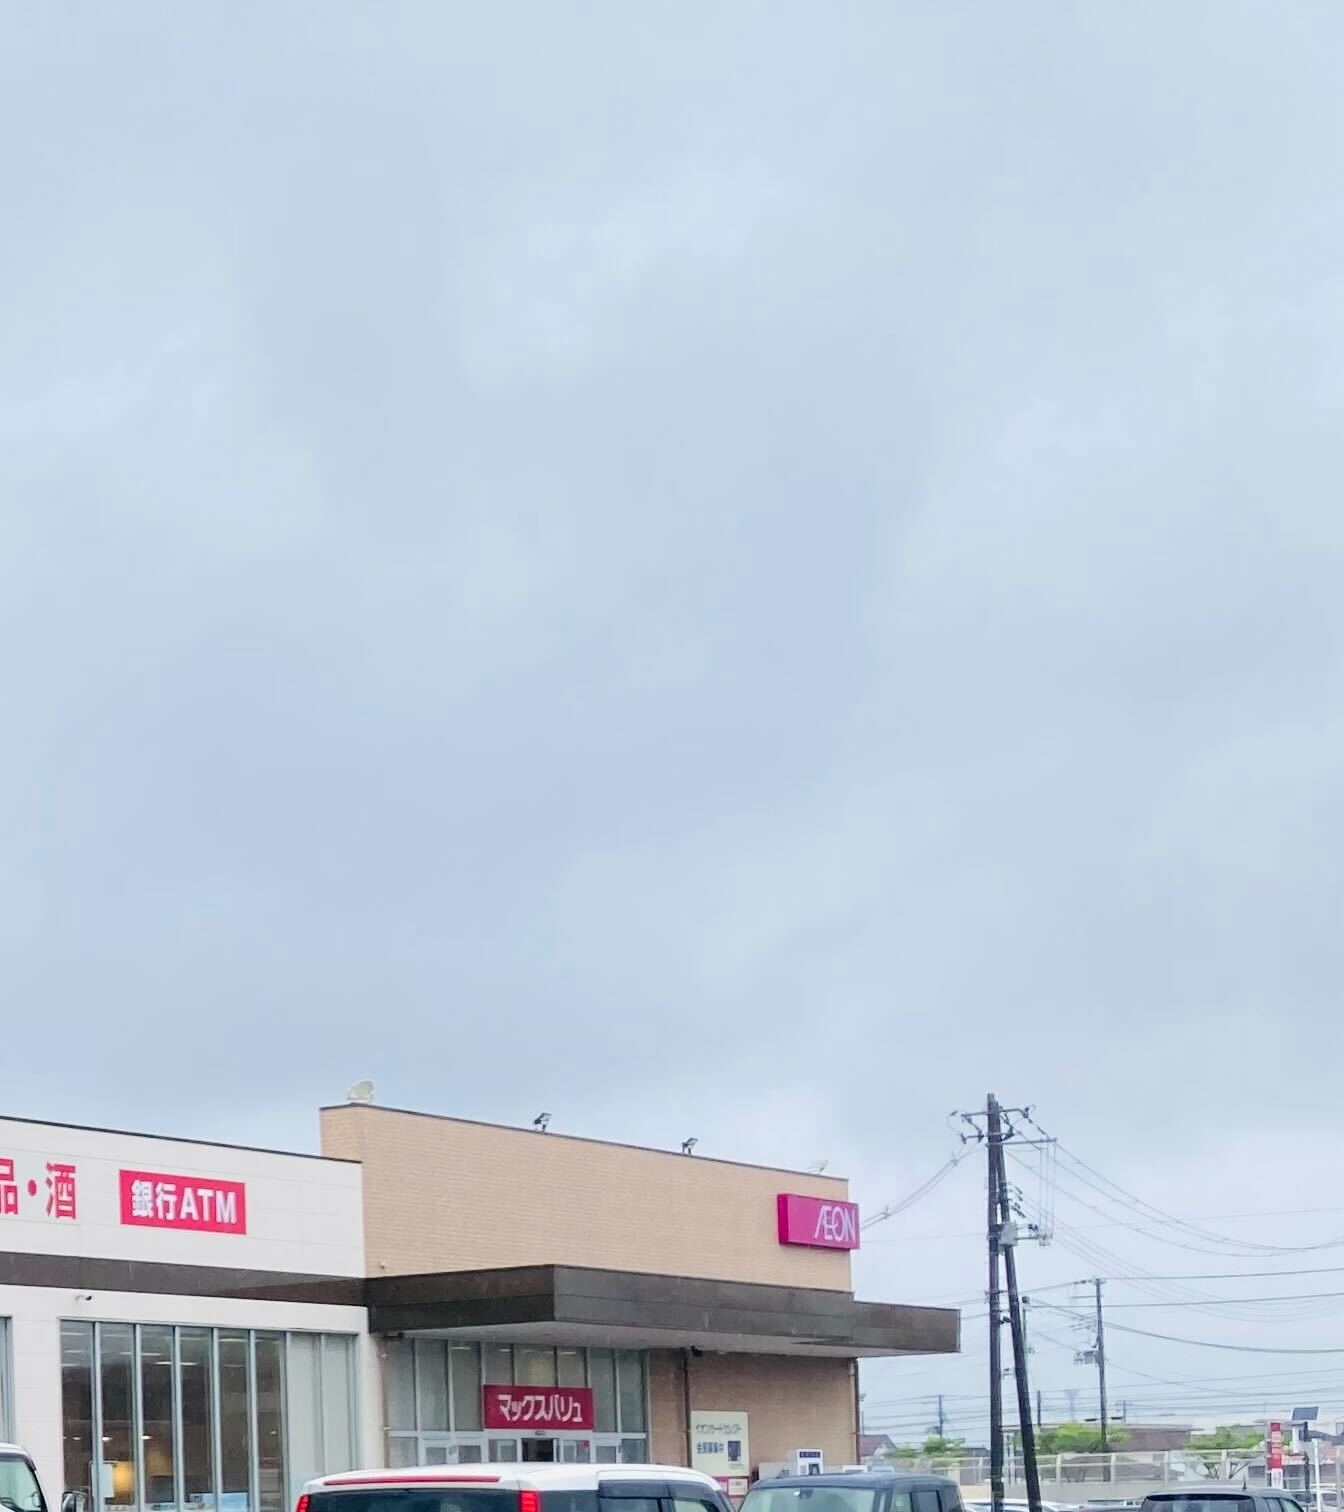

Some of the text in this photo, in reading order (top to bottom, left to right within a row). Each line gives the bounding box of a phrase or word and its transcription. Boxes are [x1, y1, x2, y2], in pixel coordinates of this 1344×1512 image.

[130, 1179, 238, 1225] 銀行ATM
[498, 1394, 584, 1422] マックスバリュ
